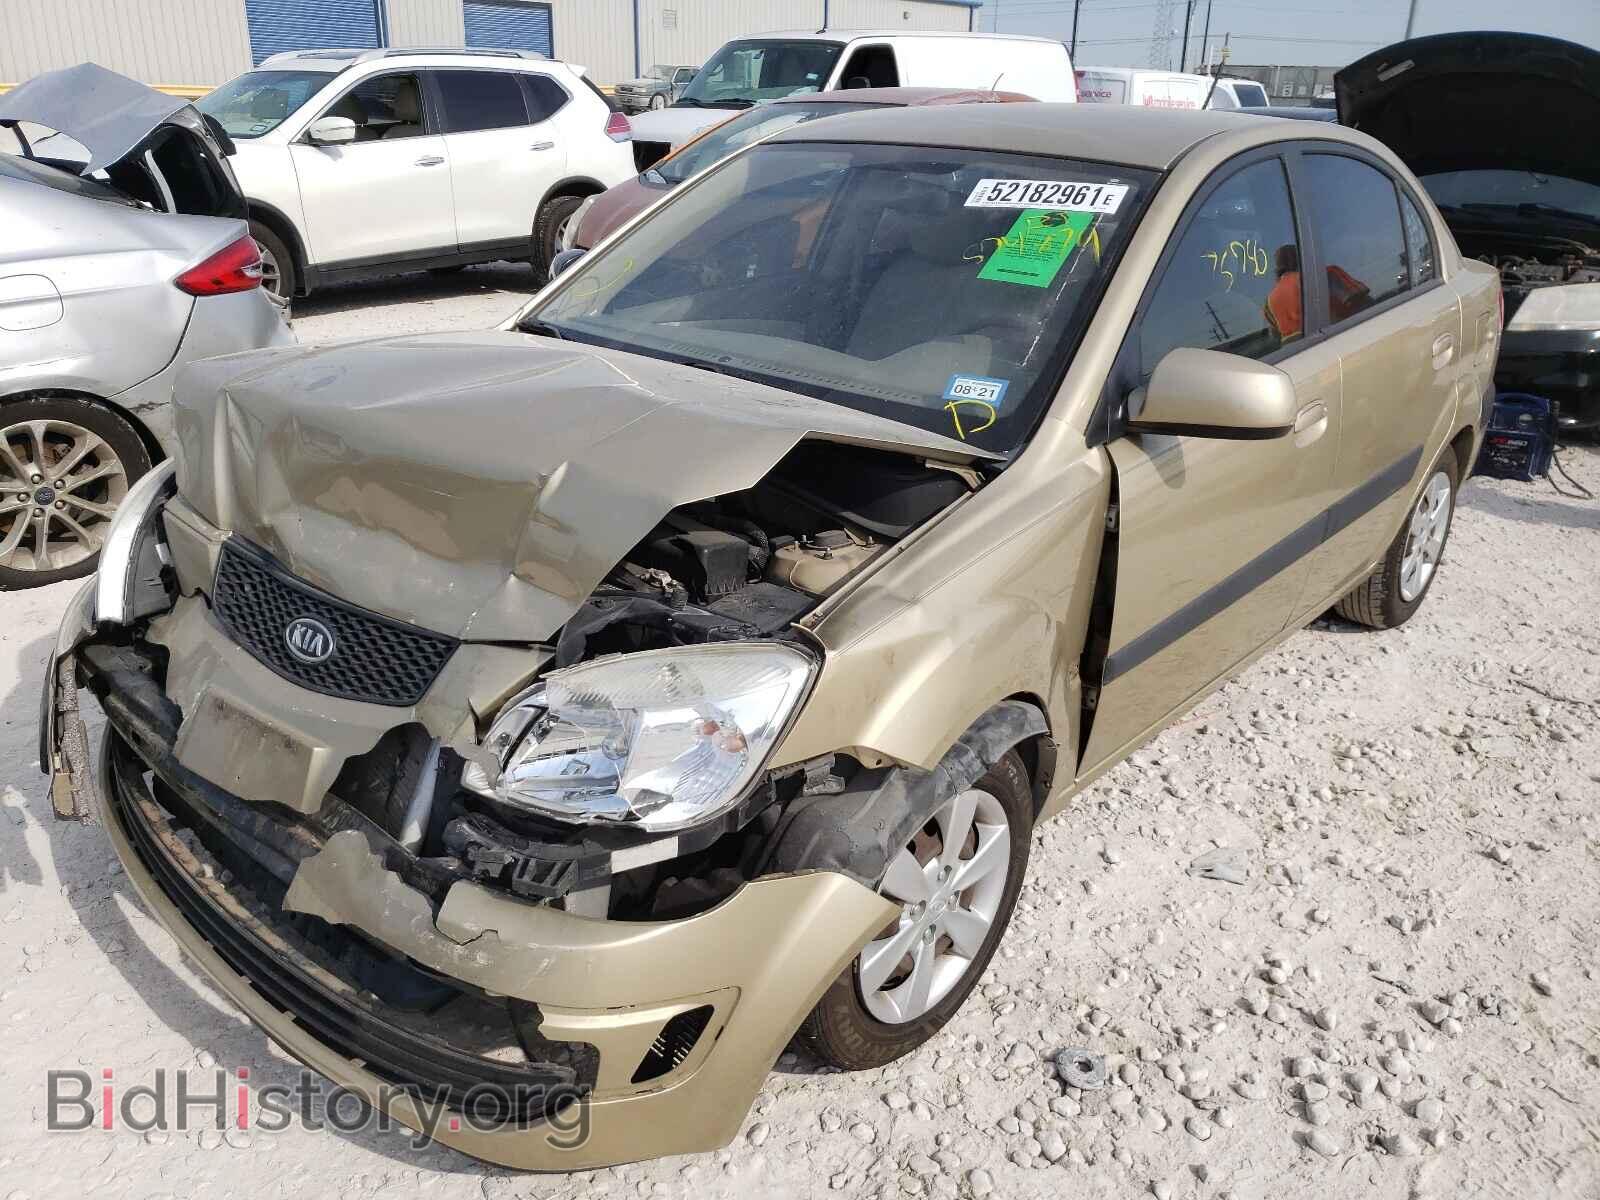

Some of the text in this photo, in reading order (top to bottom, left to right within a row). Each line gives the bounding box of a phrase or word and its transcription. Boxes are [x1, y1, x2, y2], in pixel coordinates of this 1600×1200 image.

[987, 181, 1104, 207] 52182961
[1104, 194, 1114, 206] E
[954, 384, 972, 395] 08
[977, 387, 995, 398] 21
[291, 623, 324, 657] KIA
